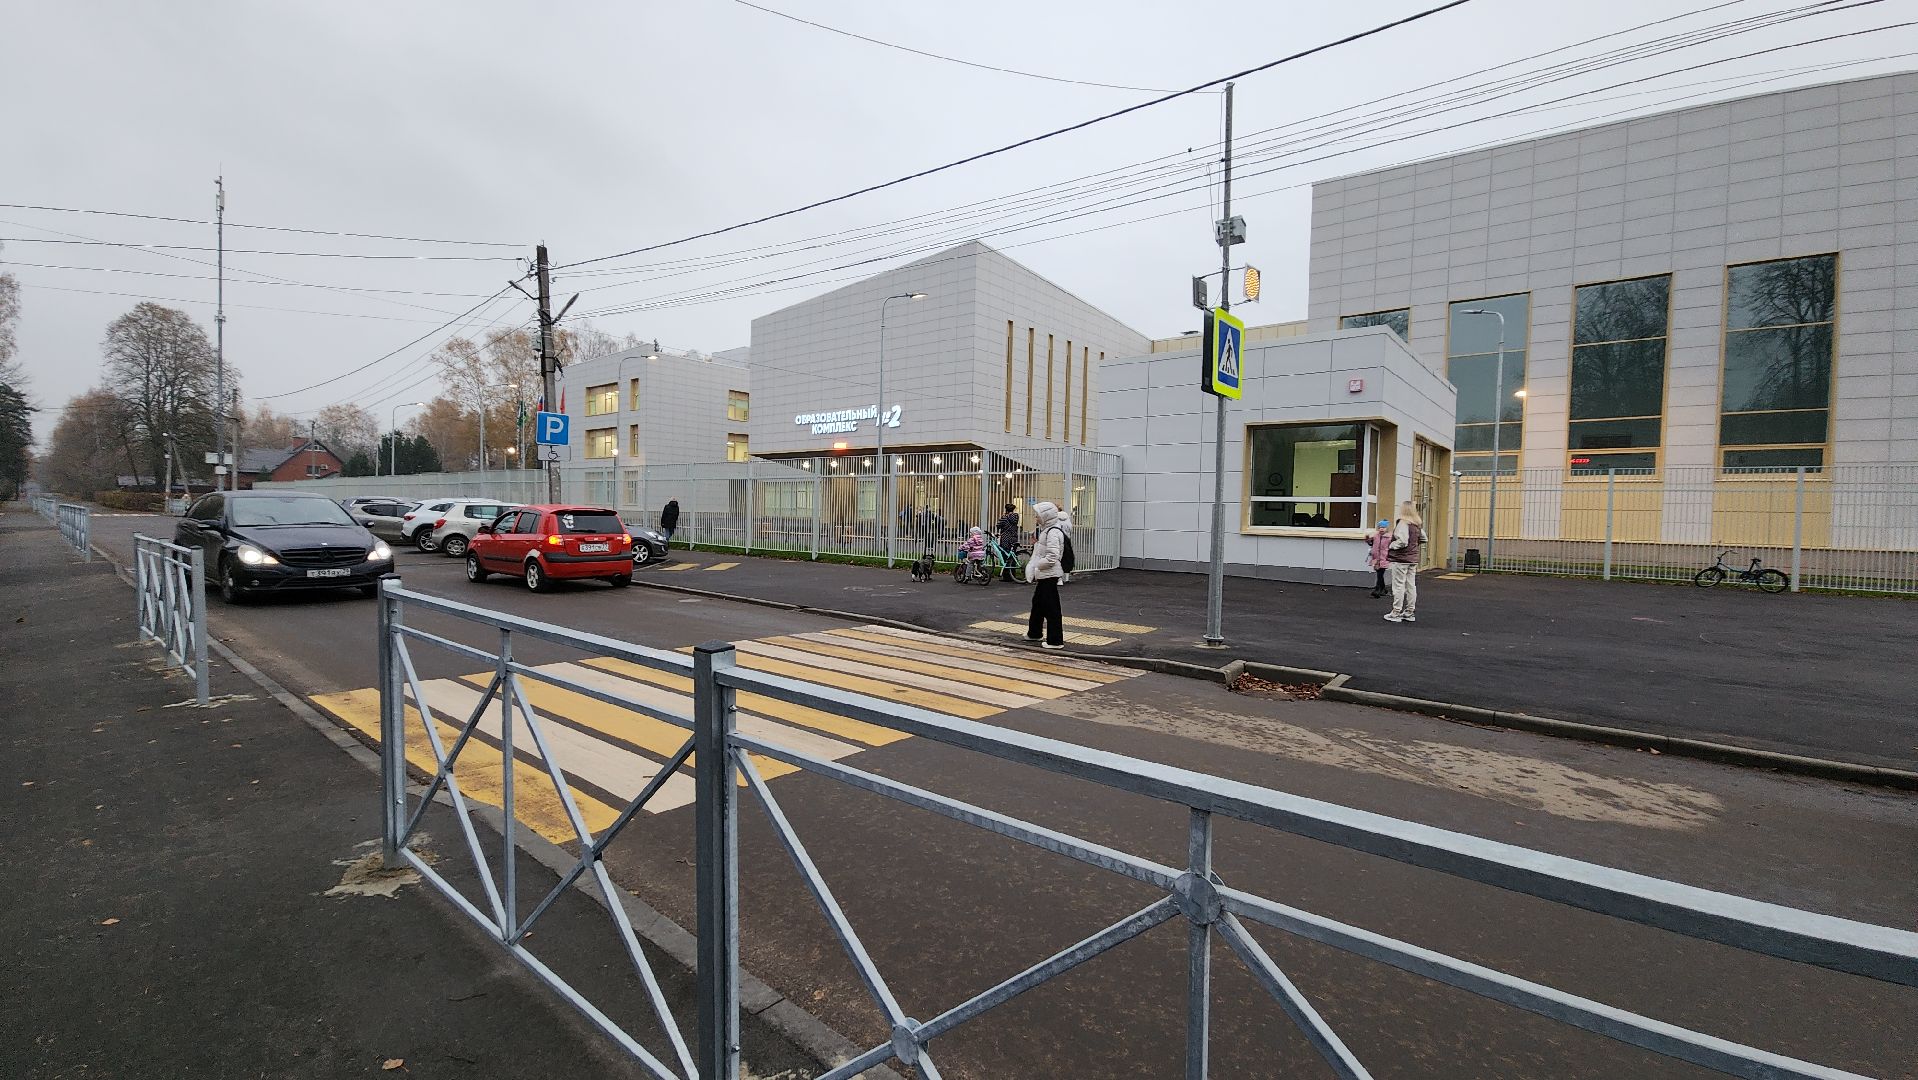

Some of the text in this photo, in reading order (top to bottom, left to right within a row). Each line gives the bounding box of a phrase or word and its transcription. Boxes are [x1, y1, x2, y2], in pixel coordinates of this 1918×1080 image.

[795, 404, 878, 425] ОБРАЗОВАТЕЛЬНЫЙ
[545, 416, 564, 440] P
[811, 420, 858, 435] КОМПЛЕКС
